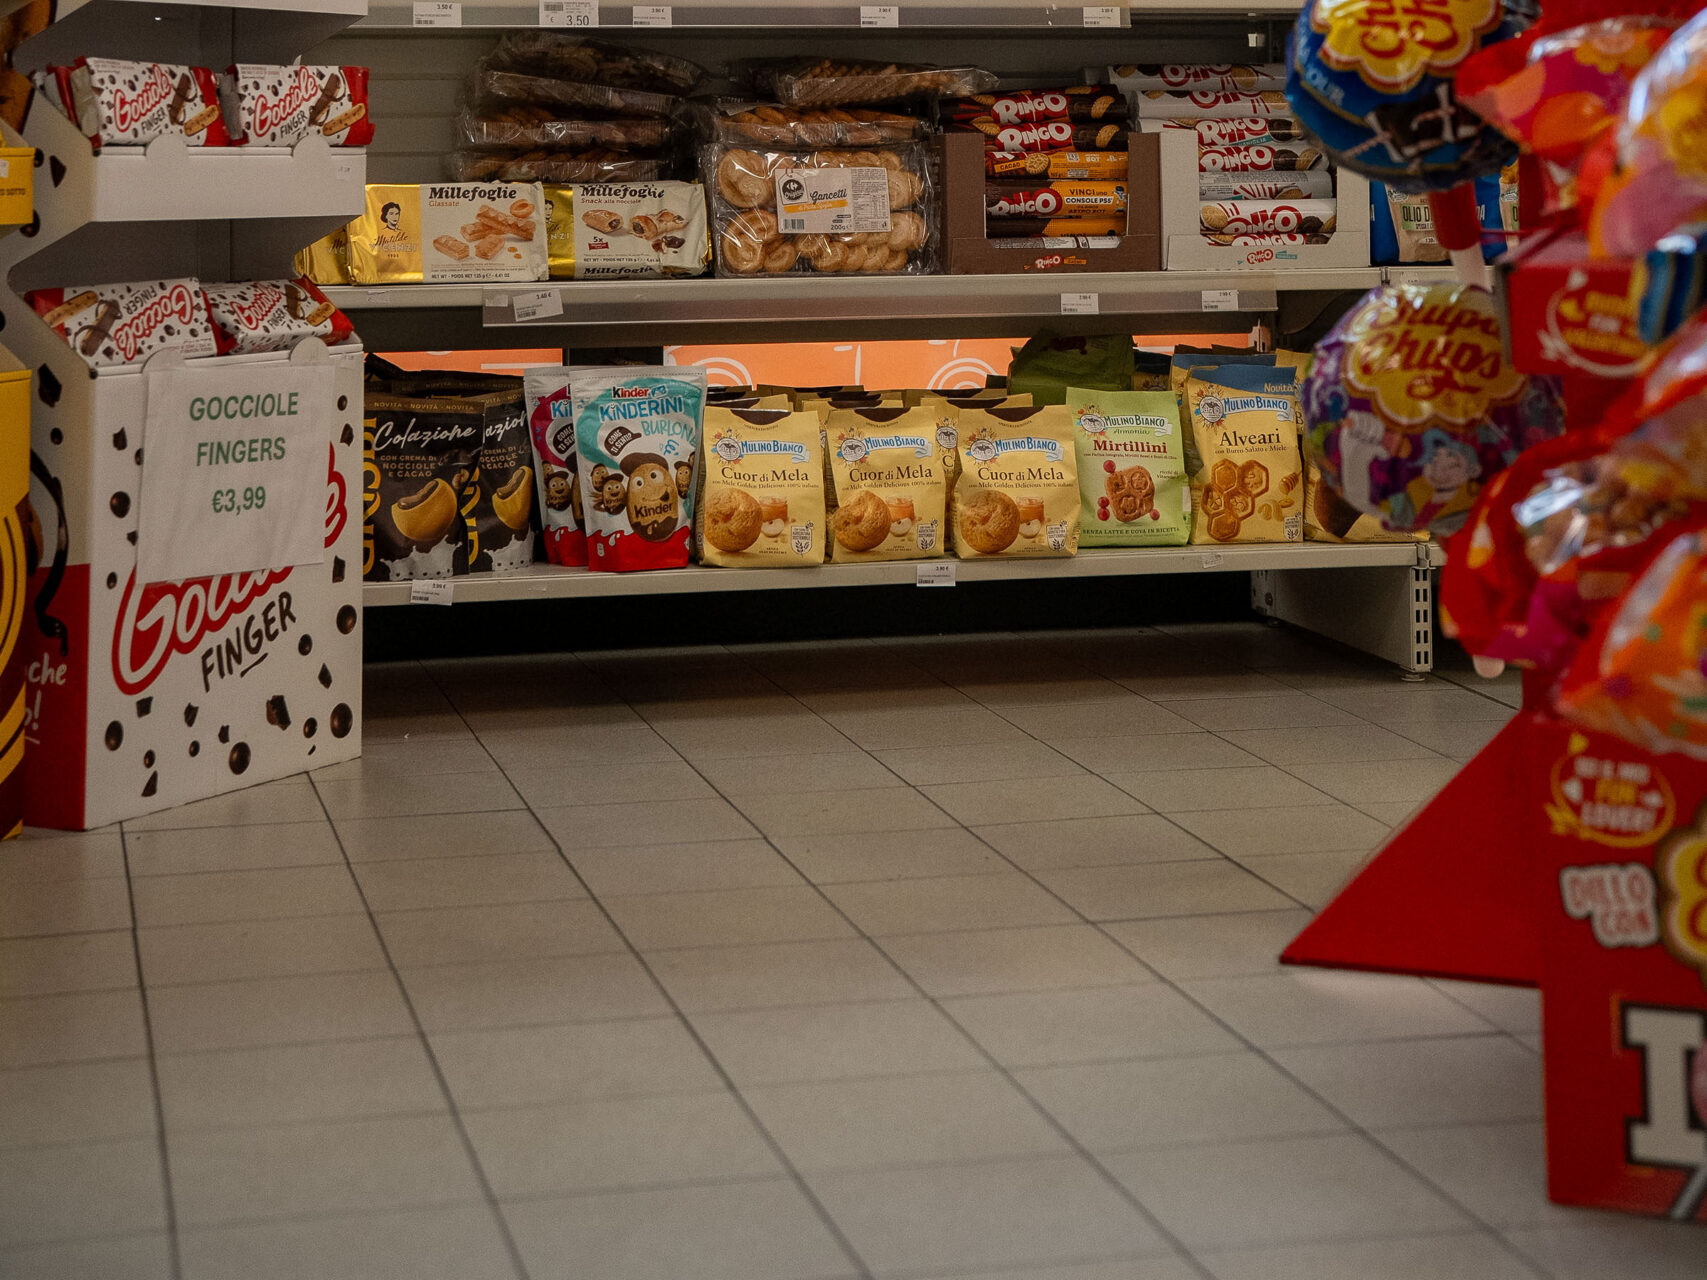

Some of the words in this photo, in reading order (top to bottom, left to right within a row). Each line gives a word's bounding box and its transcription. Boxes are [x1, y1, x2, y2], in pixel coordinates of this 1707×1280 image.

[114, 64, 172, 132] Gocciole
[253, 66, 319, 137] Gocciole
[992, 94, 1068, 123] RINGO
[279, 110, 309, 140] FINGER
[997, 122, 1072, 151] RINGO
[1000, 162, 1021, 170] CACAO
[429, 186, 517, 202] Millefoglie
[581, 184, 665, 200] Millefoglie
[1069, 188, 1095, 196] VINCI
[1403, 206, 1421, 222] OLIO
[115, 284, 194, 361] Gocciole
[1264, 382, 1293, 393] Novità
[189, 391, 299, 421] GOCCIOLE
[600, 397, 684, 422] KINDERINI
[1224, 397, 1255, 410] MULINO
[1255, 396, 1288, 411] BIANCO
[1104, 415, 1134, 427] MULINO
[1135, 415, 1165, 428] BIANCO
[373, 418, 477, 452] Colazione
[608, 430, 622, 445] COME
[865, 437, 895, 449] MULINO
[895, 436, 925, 448] BIANCO
[1219, 428, 1281, 447] Alveari
[196, 437, 286, 468] FINGERS
[741, 441, 772, 452] MULINO
[773, 440, 804, 454] BIANCO
[995, 439, 1026, 452] MULINO
[1026, 437, 1057, 452] BIANCO
[1093, 439, 1167, 454] Mirtillini
[721, 466, 758, 482] Cuor
[759, 473, 770, 483] di
[771, 469, 809, 482] Mela
[849, 467, 885, 483] Cuor
[885, 471, 895, 481] di
[896, 466, 933, 480] Mela
[978, 467, 1014, 481] Cuor
[1015, 472, 1025, 481] di
[1026, 467, 1064, 480] Mela
[212, 485, 267, 516] €3,99
[201, 591, 297, 693] FINGER
